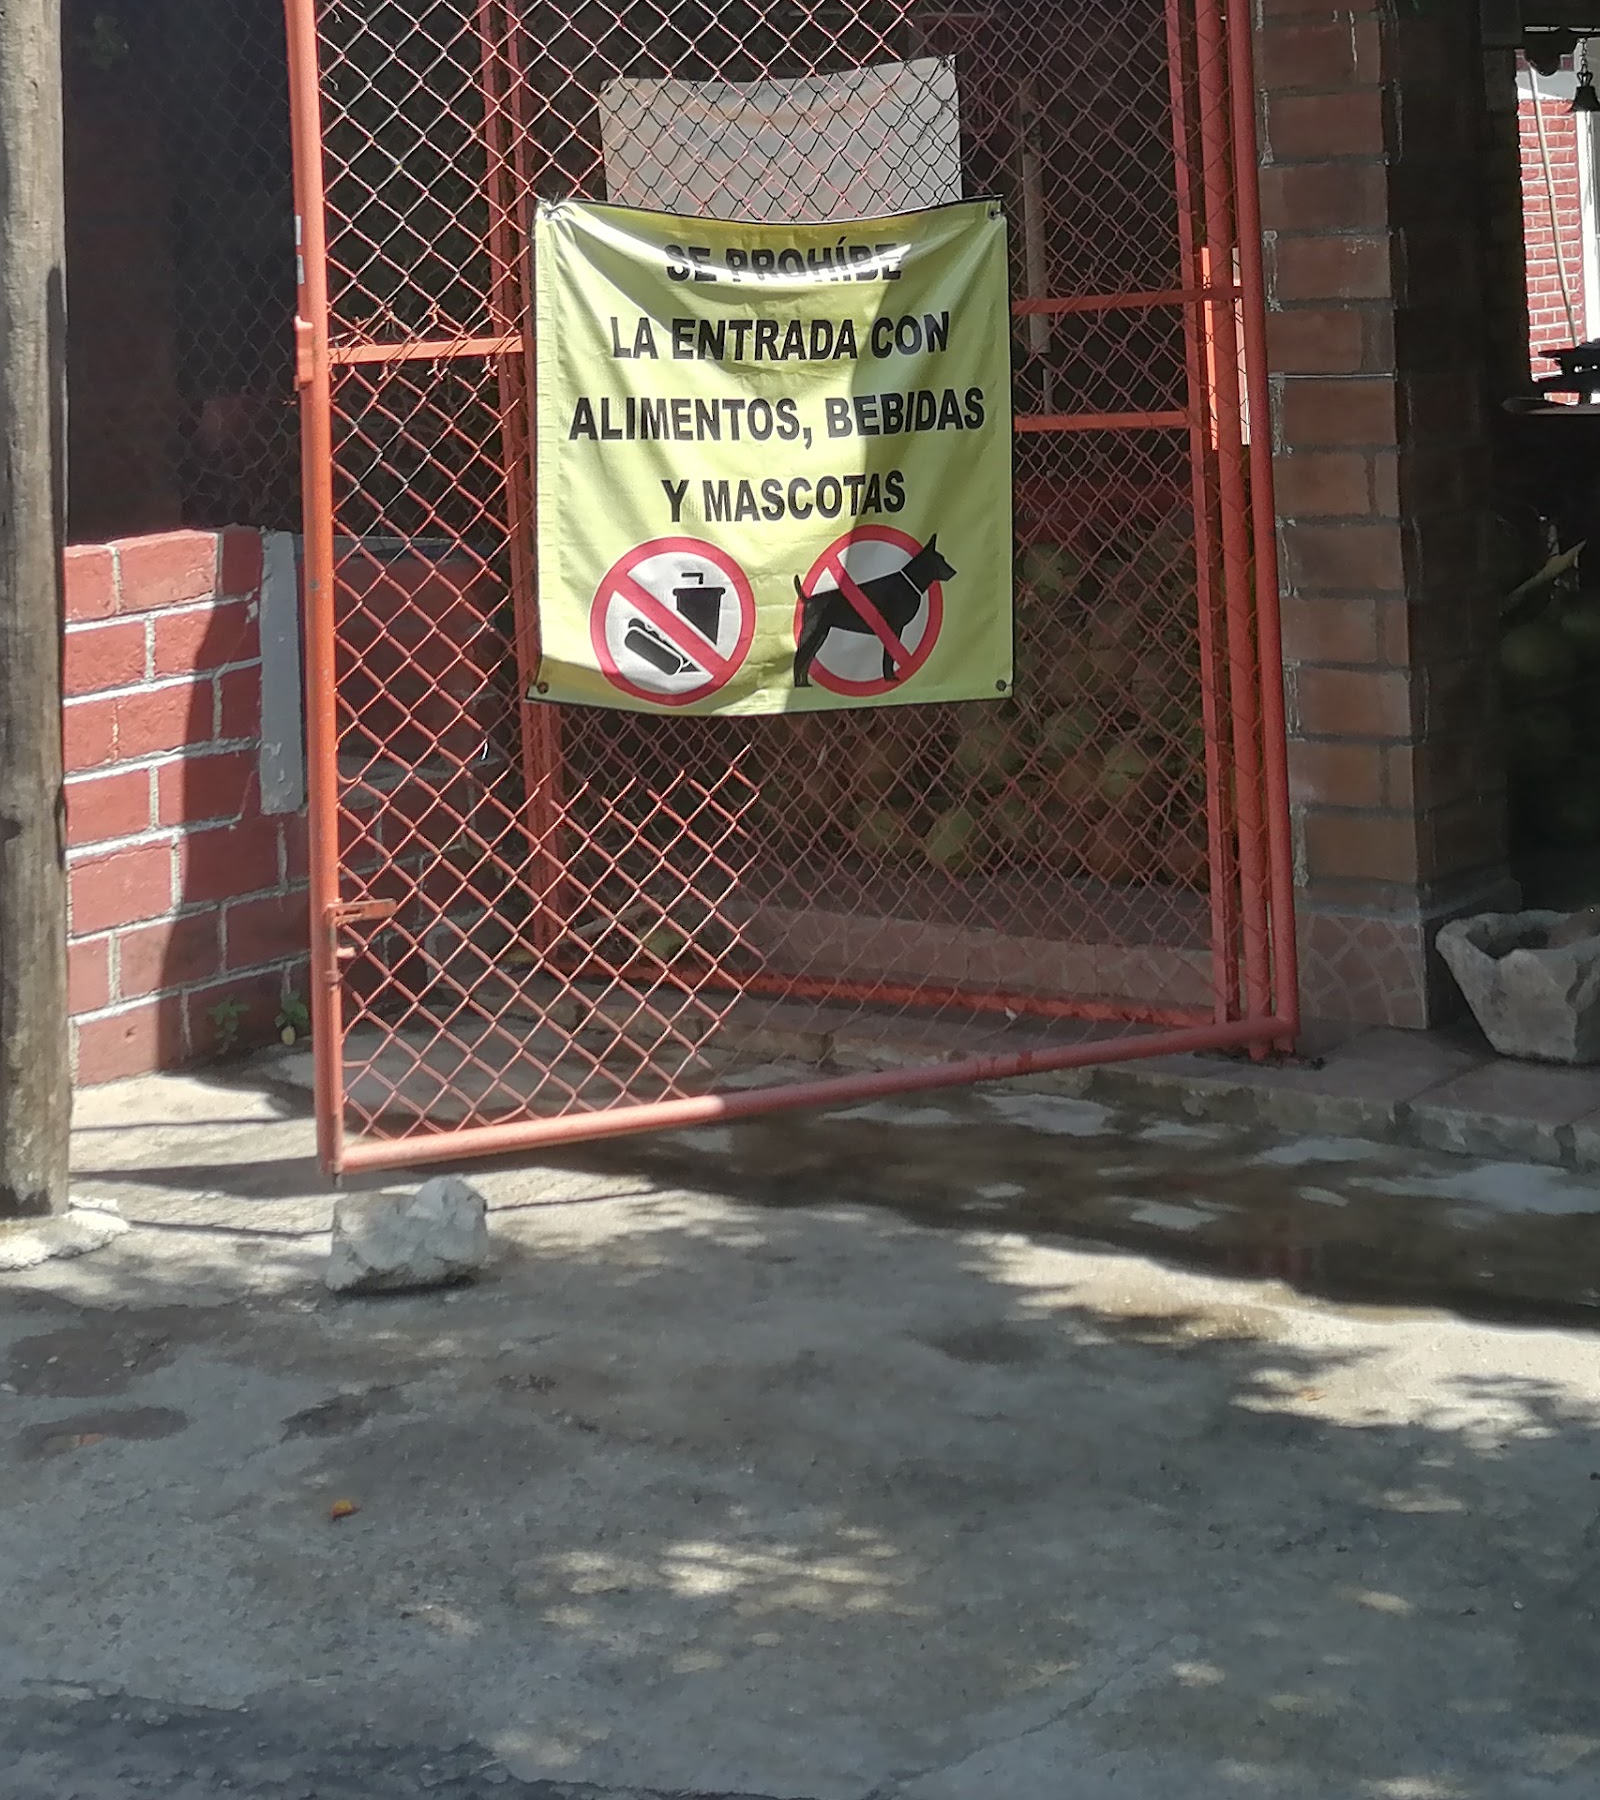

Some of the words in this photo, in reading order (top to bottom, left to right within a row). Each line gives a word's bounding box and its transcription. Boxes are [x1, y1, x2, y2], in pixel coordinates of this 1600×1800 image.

[665, 244, 717, 282] SE
[610, 316, 659, 360] LA
[671, 318, 858, 361] ENTRADA
[871, 311, 950, 359] CON
[568, 397, 813, 449] ALIMENTOS,
[825, 387, 986, 439] BEBIDAS
[661, 479, 690, 523] Y
[702, 470, 907, 523] MASCOTAS
